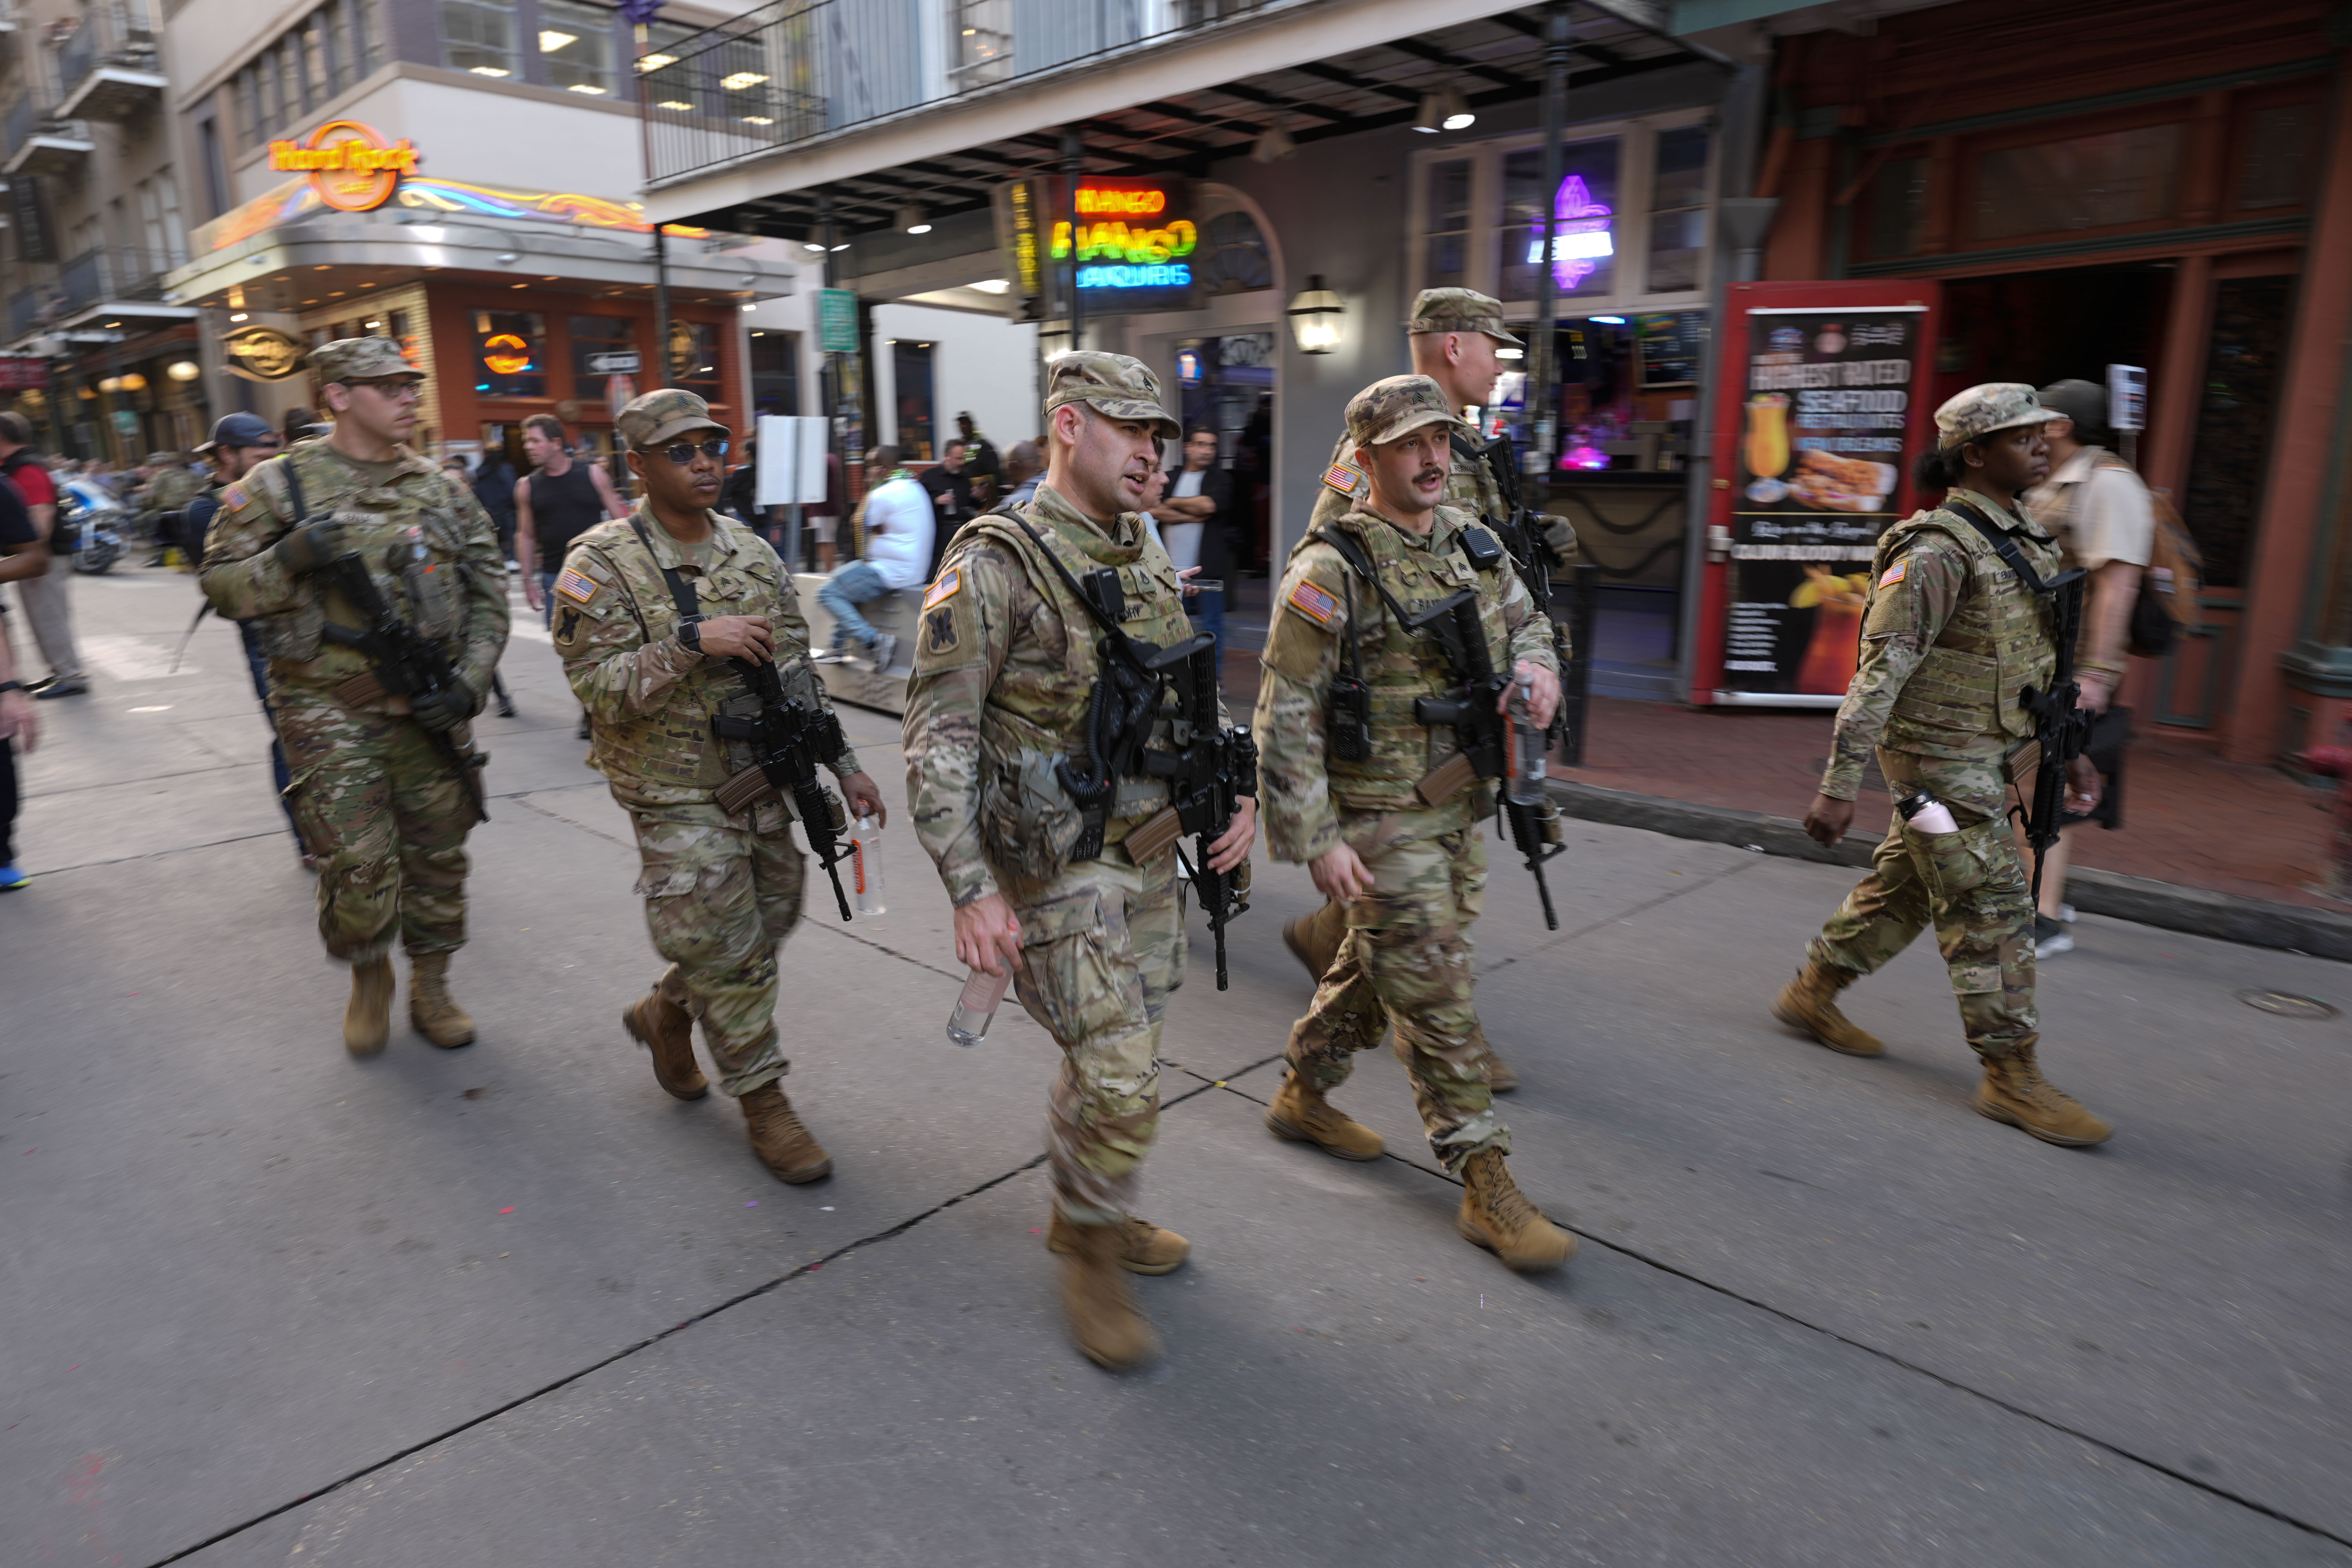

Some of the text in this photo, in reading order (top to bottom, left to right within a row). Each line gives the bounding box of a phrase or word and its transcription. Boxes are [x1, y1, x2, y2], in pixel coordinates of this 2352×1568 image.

[269, 138, 420, 176] Hard Rock
[1796, 390, 1908, 413] SEAFOOD
